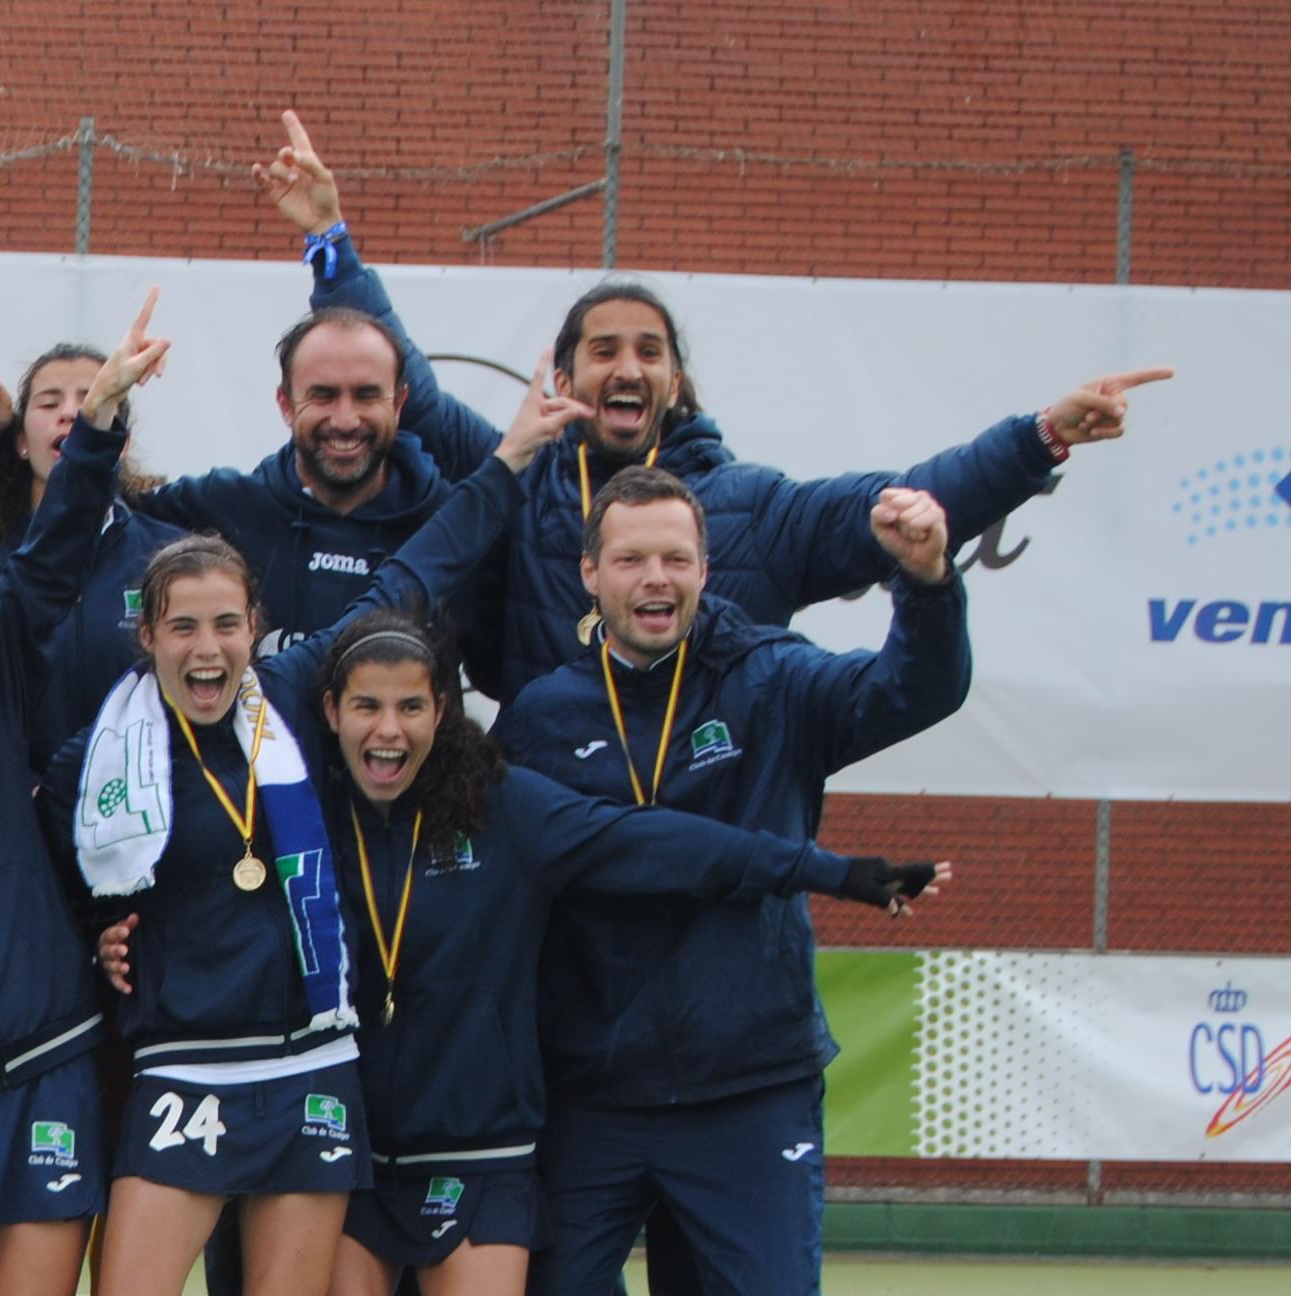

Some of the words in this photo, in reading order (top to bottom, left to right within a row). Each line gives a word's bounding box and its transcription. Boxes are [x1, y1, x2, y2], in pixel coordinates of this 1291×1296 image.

[1188, 1022, 1264, 1095] CSD
[149, 1091, 225, 1157] 24
[319, 1126, 327, 1136] de
[45, 1155, 54, 1165] de
